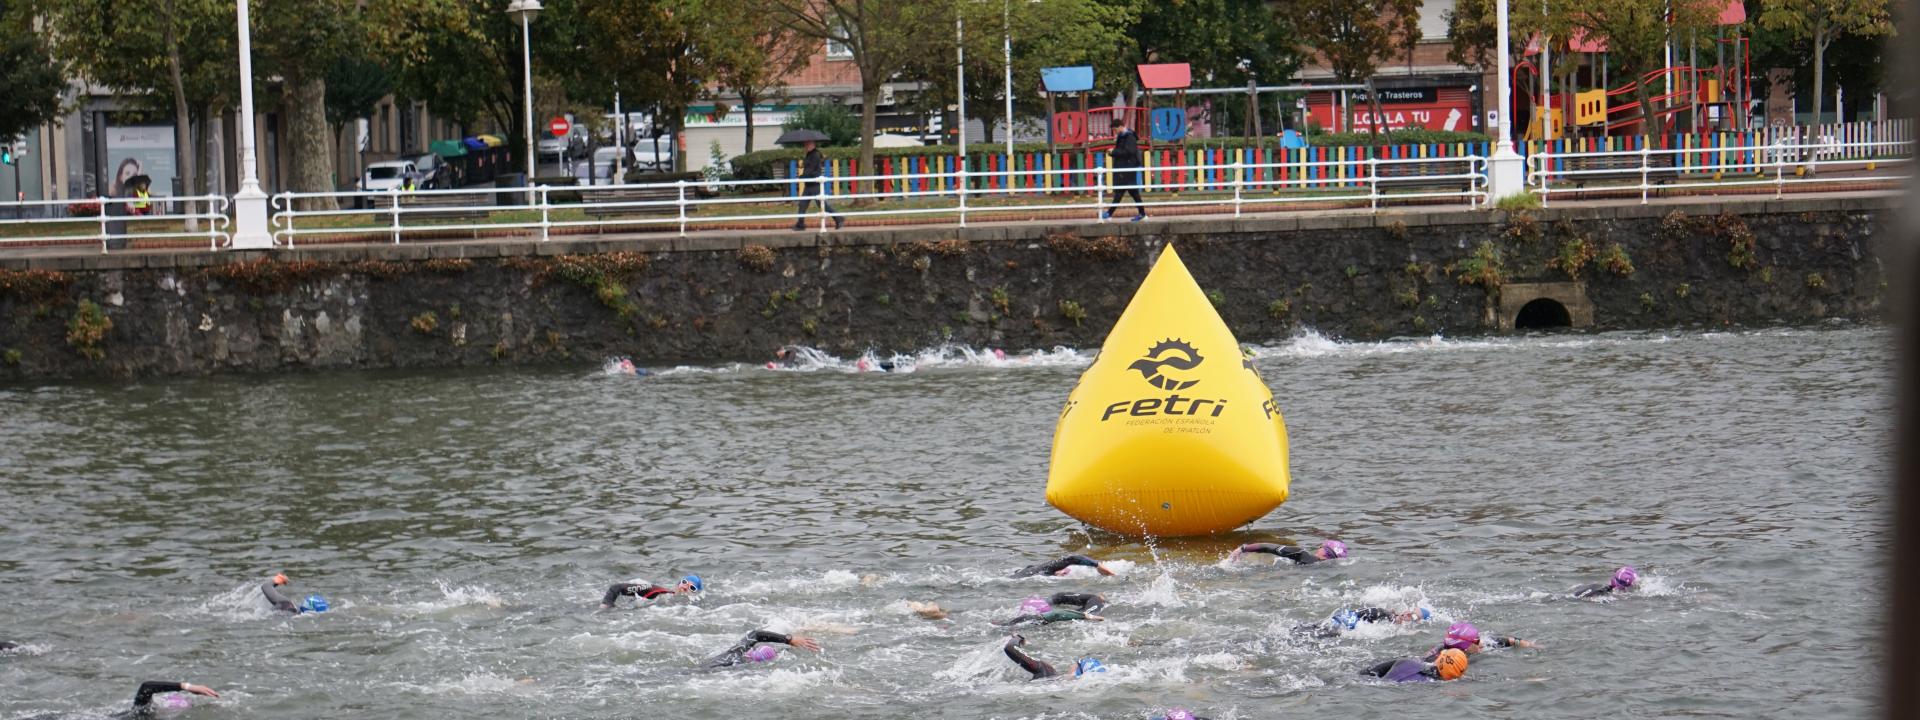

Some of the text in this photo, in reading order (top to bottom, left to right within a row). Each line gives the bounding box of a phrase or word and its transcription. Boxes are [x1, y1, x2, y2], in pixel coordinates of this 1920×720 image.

[1386, 91, 1423, 99] Trasteros
[1411, 111, 1430, 123] TU
[1175, 418, 1216, 426] ESPAÑOLA
